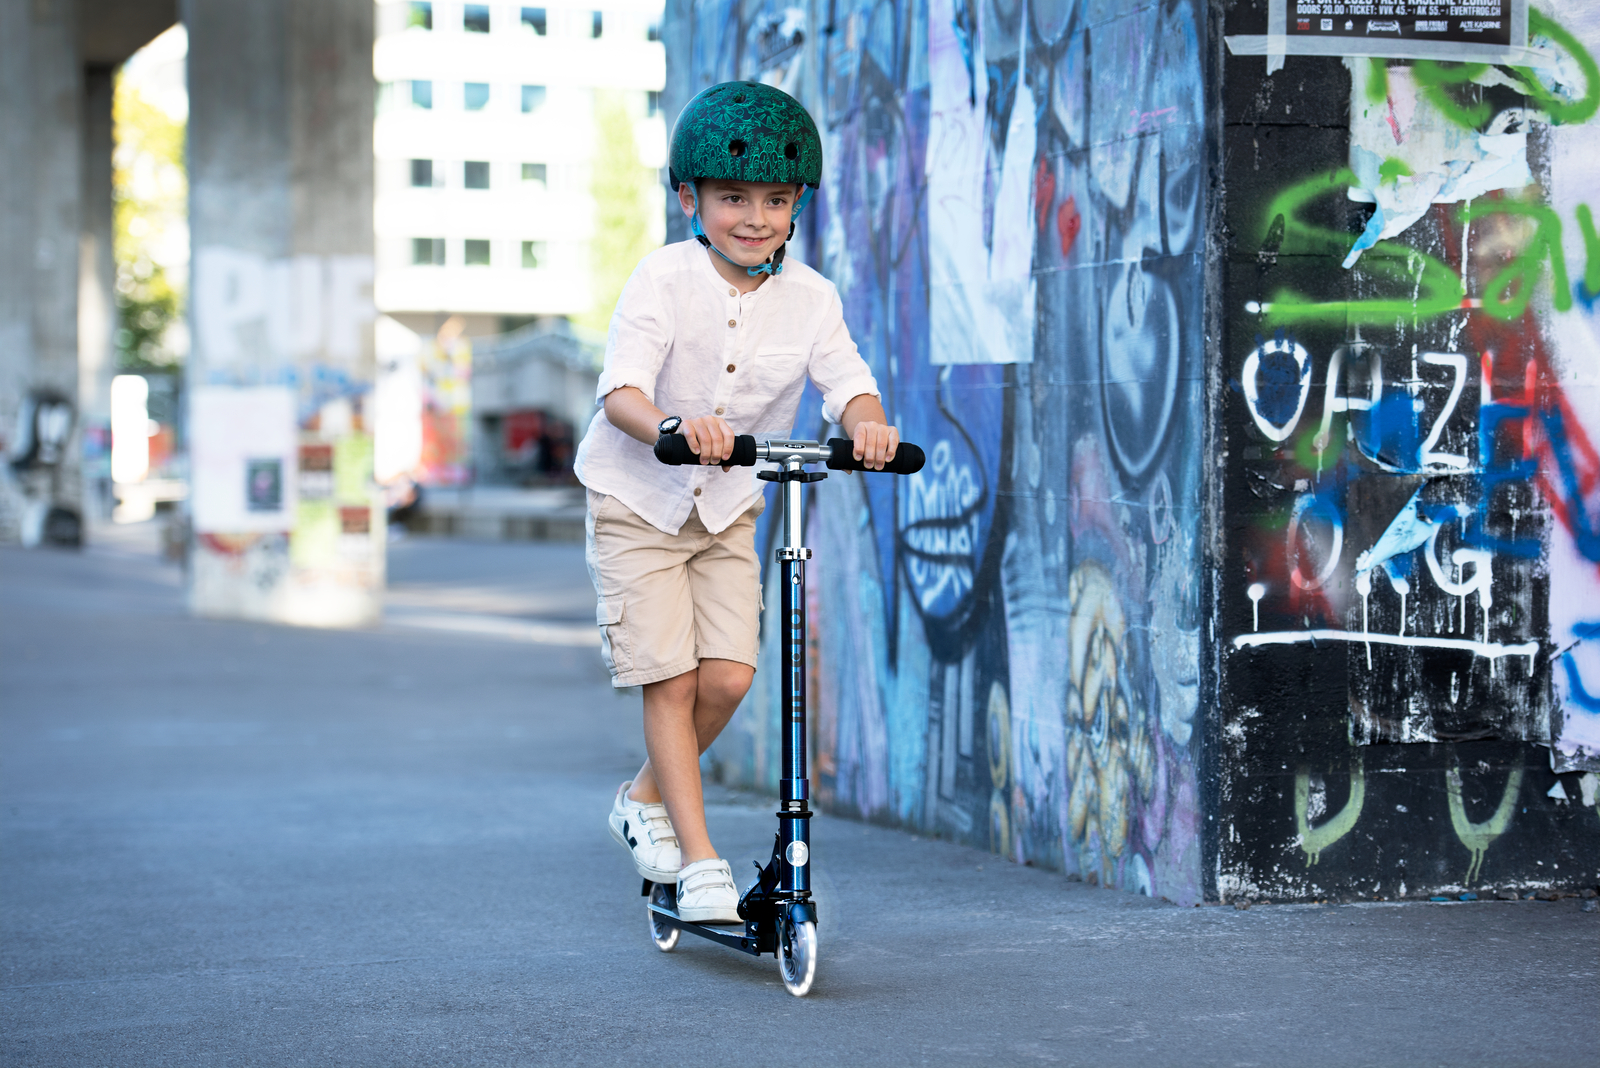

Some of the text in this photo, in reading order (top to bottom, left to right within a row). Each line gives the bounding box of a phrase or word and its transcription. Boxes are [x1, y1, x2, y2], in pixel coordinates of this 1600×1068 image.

[1297, 4, 1321, 14] DOORS
[1322, 5, 1344, 15] 20.00
[1349, 5, 1377, 15] TICKET:
[1379, 5, 1394, 15] VVK
[1417, 6, 1427, 15] AK
[1450, 6, 1501, 15] EVENTFROG.CH
